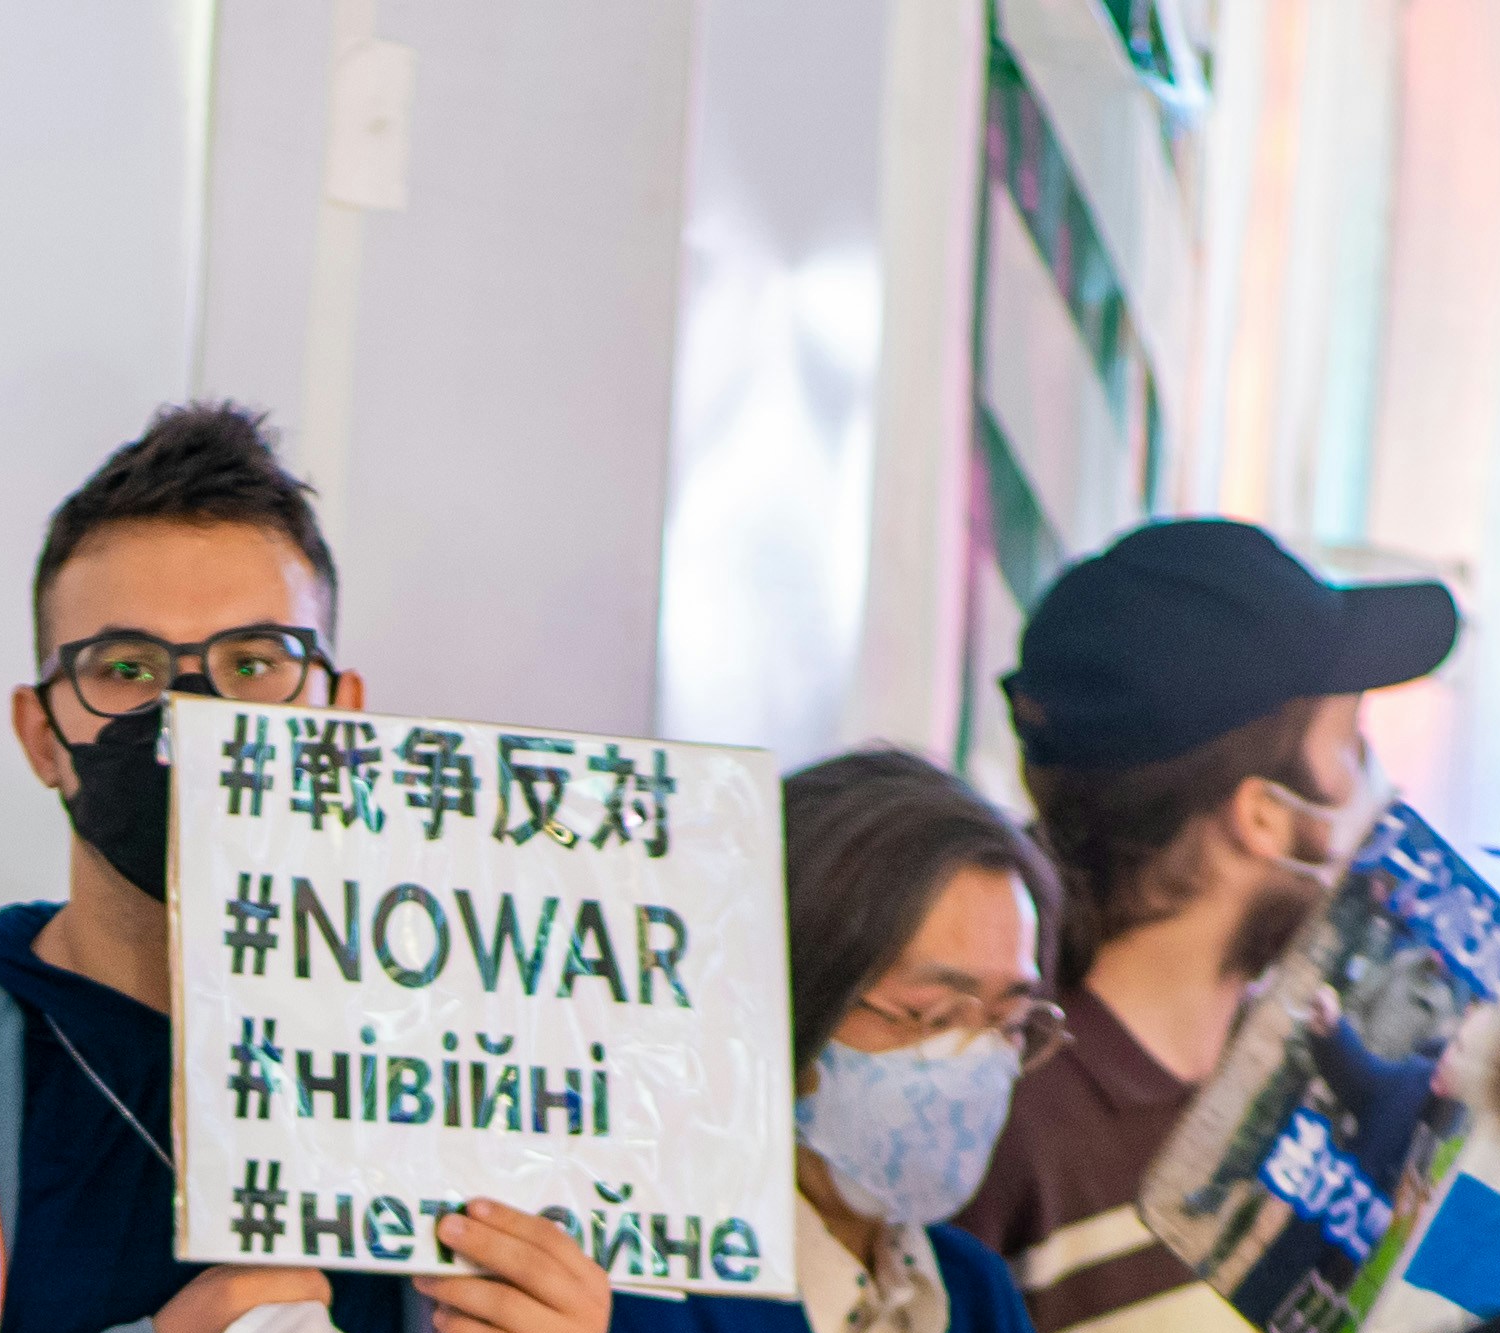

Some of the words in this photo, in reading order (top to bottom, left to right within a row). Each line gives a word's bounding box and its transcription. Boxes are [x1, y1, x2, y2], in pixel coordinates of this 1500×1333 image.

[219, 714, 677, 858] #戦争反対
[225, 872, 693, 1007] #NOWAR
[228, 1017, 611, 1138] #нівійні
[230, 1160, 760, 1283] #нетйне
